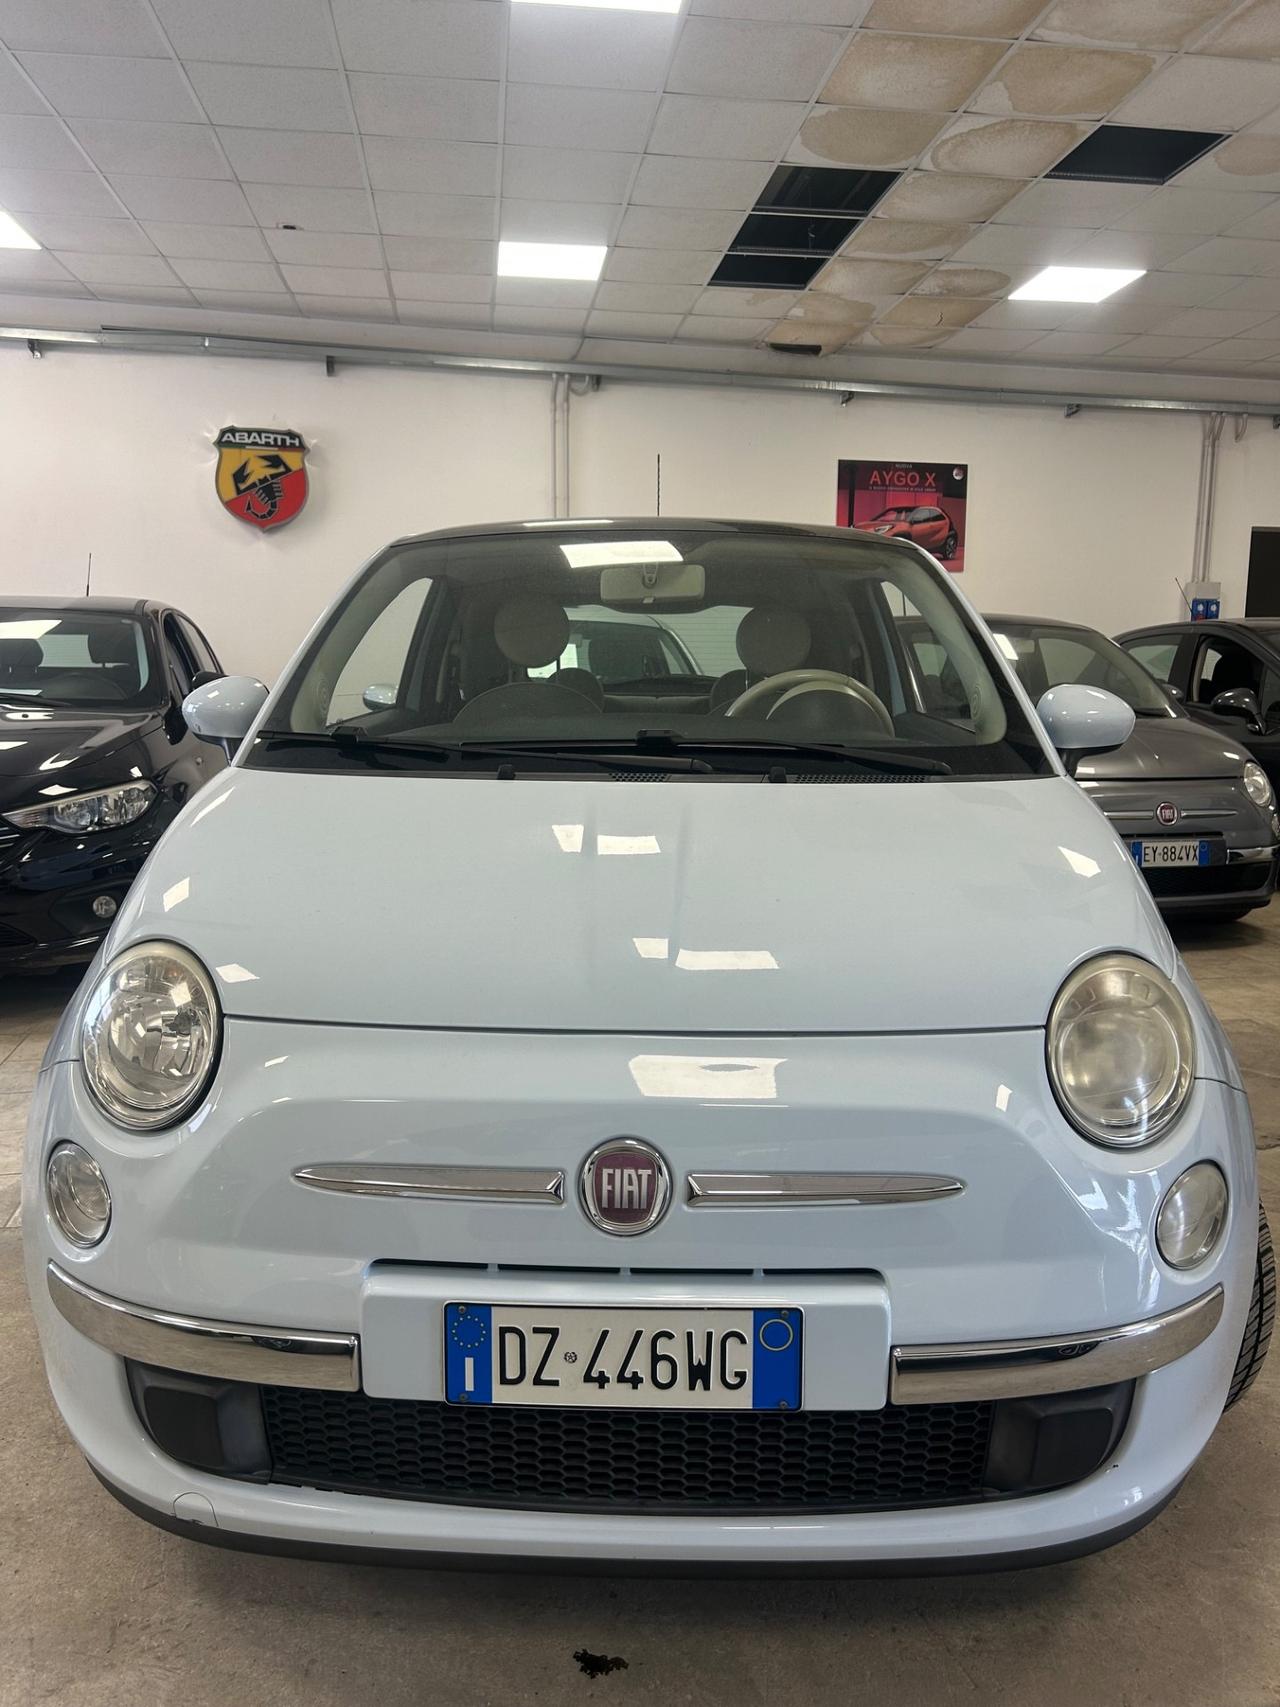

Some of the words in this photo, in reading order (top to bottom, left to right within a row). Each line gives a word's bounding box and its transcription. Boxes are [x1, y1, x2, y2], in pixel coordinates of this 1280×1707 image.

[221, 432, 299, 446] ABARTH
[870, 470, 919, 486] AYGO
[925, 472, 936, 487] X
[1144, 846, 1158, 862] EY
[1162, 845, 1198, 862] 884VX
[602, 1168, 652, 1209] FIAT
[499, 1326, 560, 1387] DZ
[583, 1329, 748, 1391] 446WG
